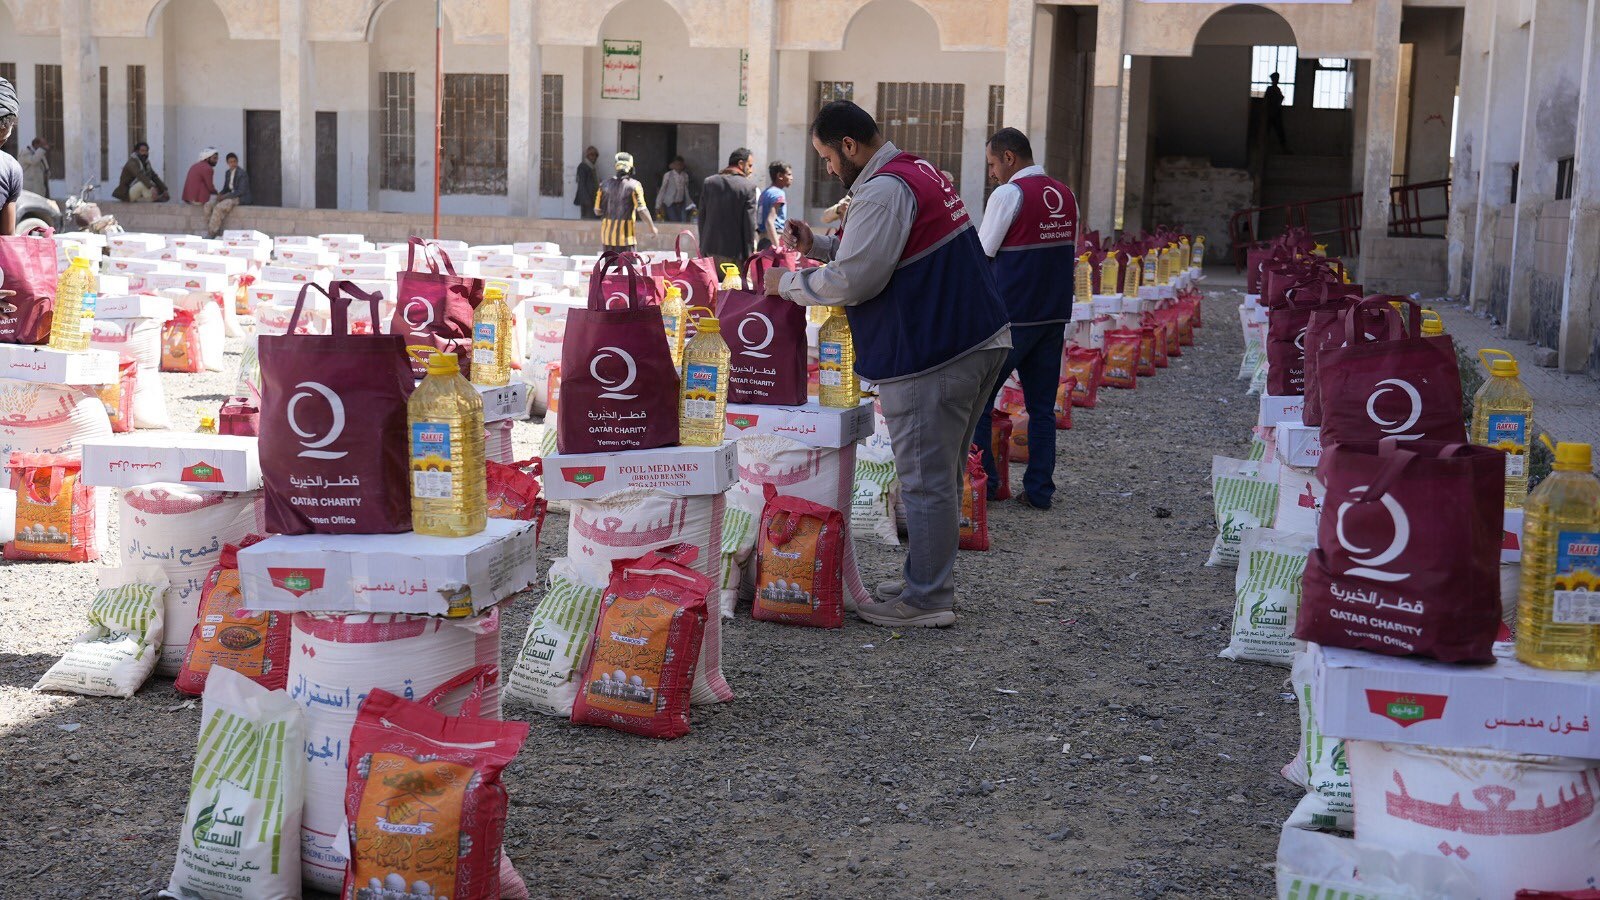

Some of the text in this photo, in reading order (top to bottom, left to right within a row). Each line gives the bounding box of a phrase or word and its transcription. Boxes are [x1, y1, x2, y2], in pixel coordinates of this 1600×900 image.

[753, 367, 776, 376] قطر
[749, 379, 775, 387] CHARITY
[735, 388, 769, 397] Yemen Office
[588, 409, 647, 421] قطر الخيرية
[589, 426, 647, 434] QATAR CHARITY
[799, 424, 816, 434] فول
[420, 432, 443, 443] RAKKIE
[597, 439, 620, 447] Yemen
[619, 463, 699, 475] FOUL MEDAMES
[290, 474, 360, 488] قطر الخيرية
[291, 497, 361, 507] QATAR CHARITY
[331, 515, 356, 525] Office
[1568, 543, 1598, 555] RAKKIE
[355, 579, 428, 596] فول مدمس
[1330, 582, 1425, 615] قطر الخيرية
[1330, 608, 1423, 636] QATAR CHARITY
[1383, 635, 1414, 651] Office
[1484, 715, 1589, 734] فول مدمس
[304, 735, 341, 767] الجو
[211, 807, 245, 828] سكر
[196, 829, 242, 848] السعيد
[240, 860, 260, 872] سكر
[194, 864, 206, 874] FINE
[207, 867, 226, 879] WHITE
[228, 873, 252, 883] SUGAR
